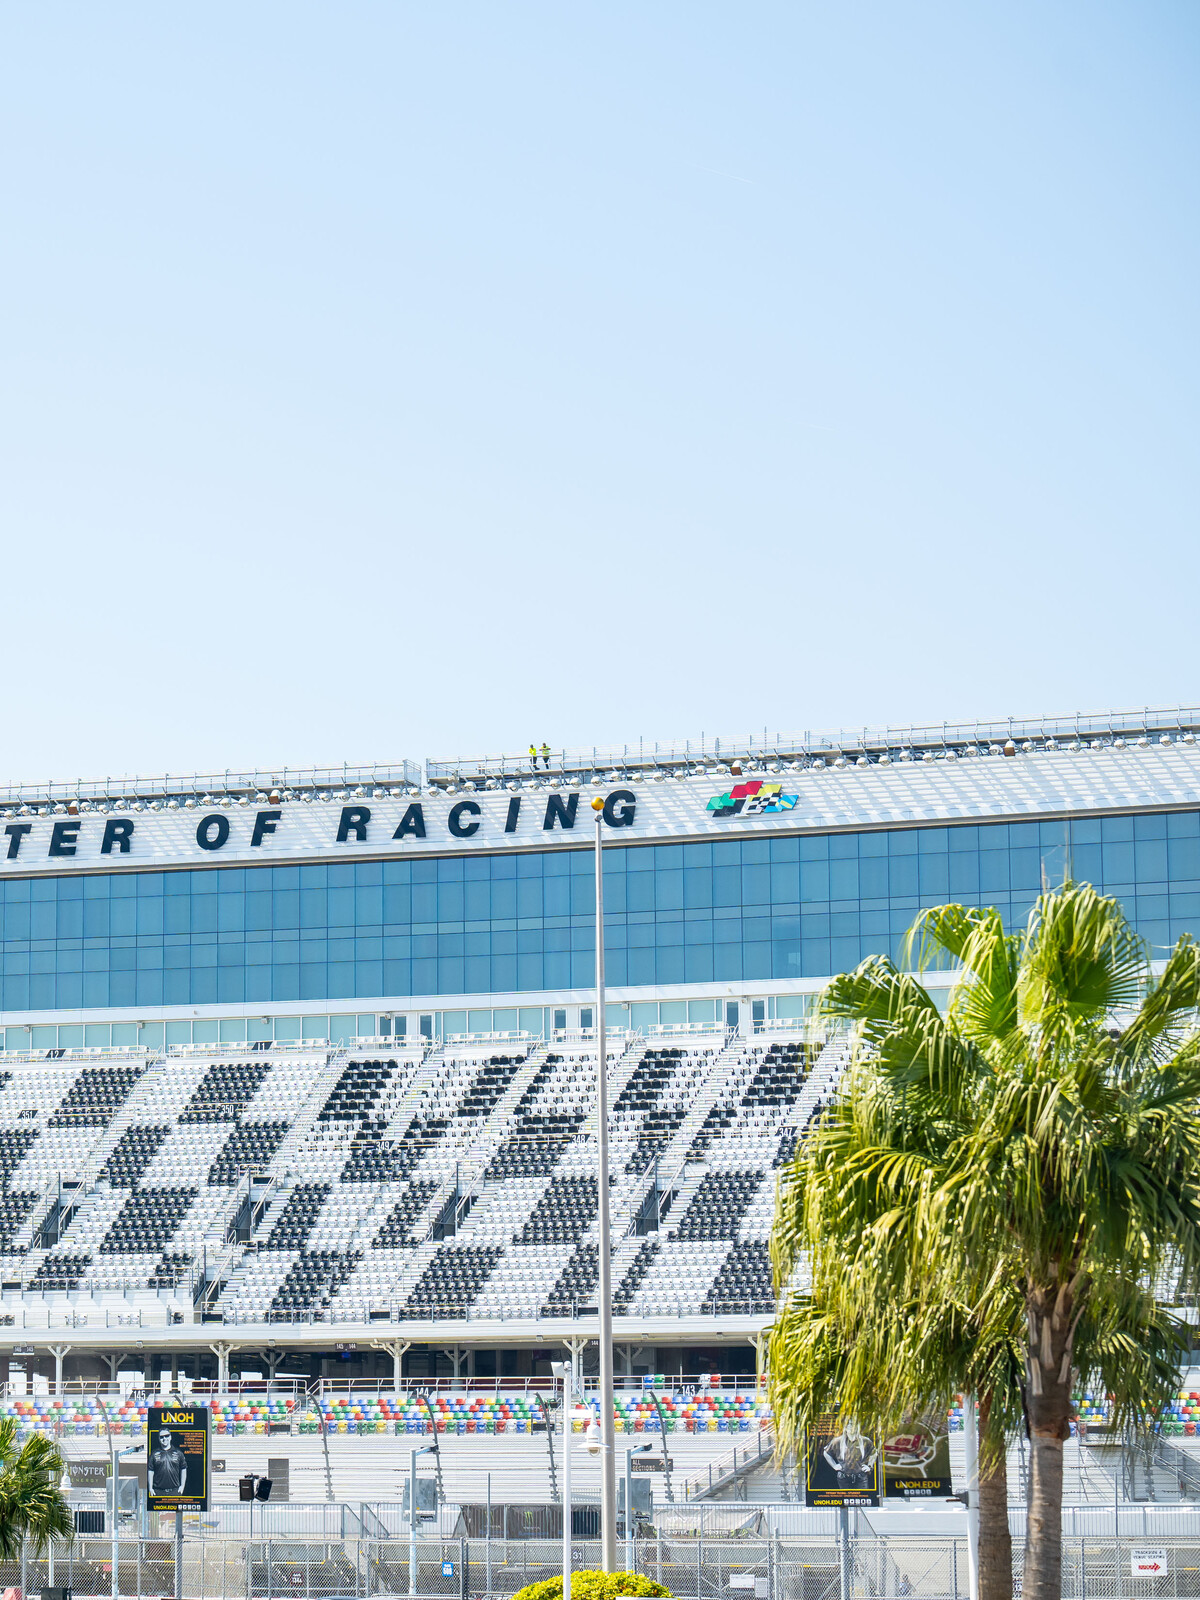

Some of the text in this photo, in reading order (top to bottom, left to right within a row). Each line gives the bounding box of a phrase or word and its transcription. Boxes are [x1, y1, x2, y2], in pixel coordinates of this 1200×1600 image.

[196, 811, 281, 851] OF
[336, 789, 636, 843] RACING
[21, 1110, 34, 1120] 351
[220, 1104, 234, 1114] 350
[779, 1126, 793, 1138] 347
[571, 1134, 586, 1144] 348
[375, 1140, 390, 1151] 349
[133, 1389, 146, 1401] 145
[415, 1386, 429, 1399] 144
[681, 1384, 696, 1397] 143
[161, 1410, 194, 1423] UNOH
[895, 1480, 940, 1489] UNOH.EDU
